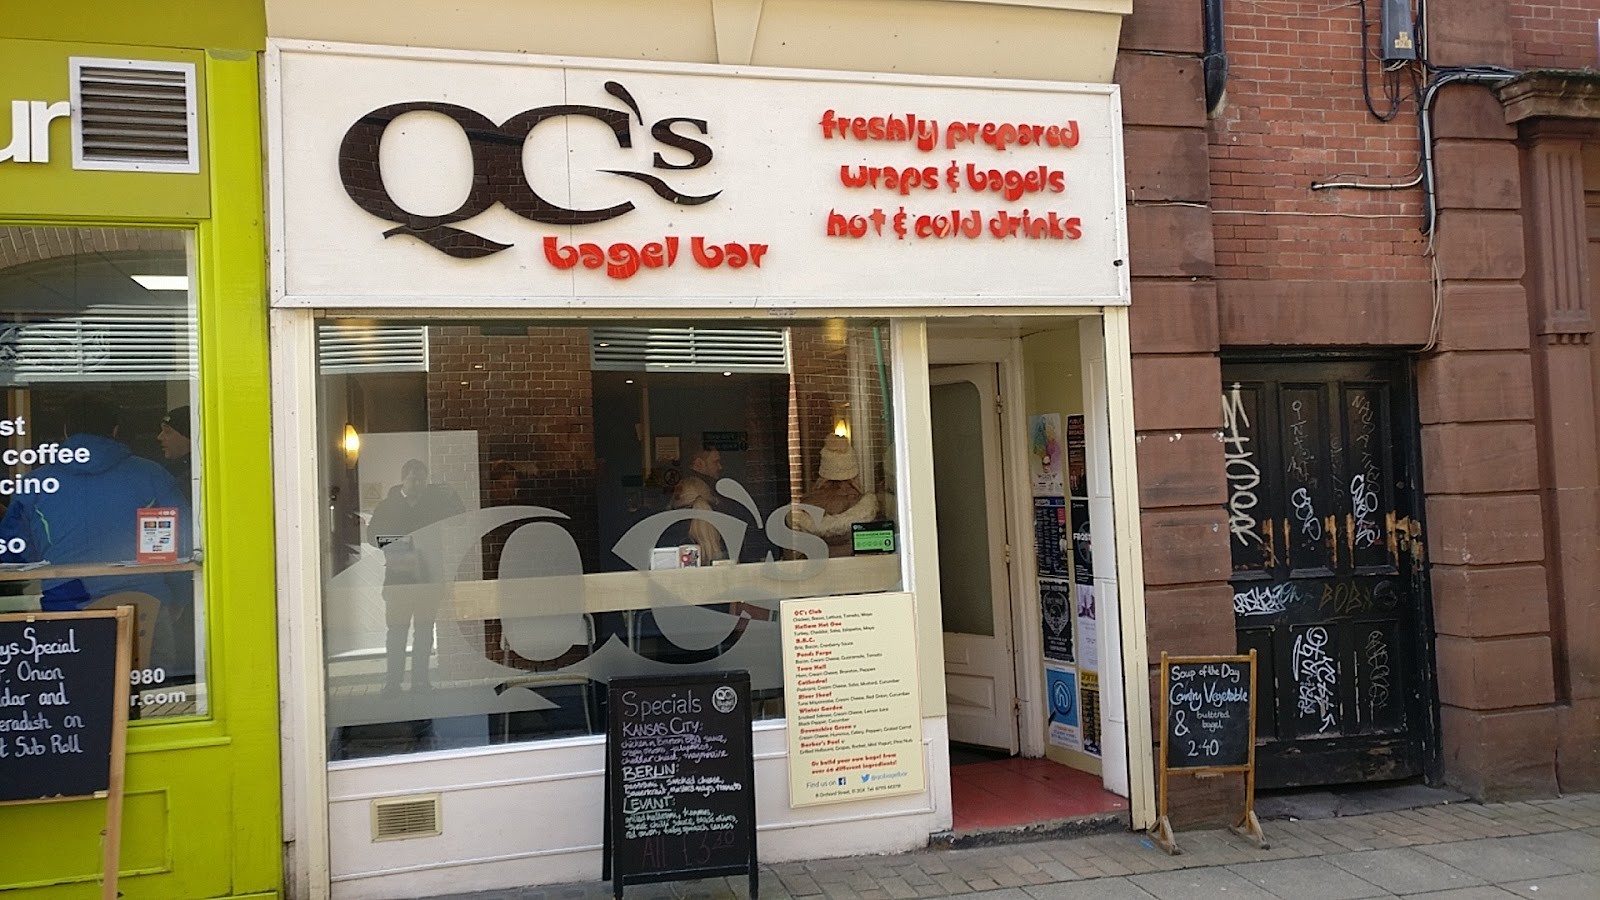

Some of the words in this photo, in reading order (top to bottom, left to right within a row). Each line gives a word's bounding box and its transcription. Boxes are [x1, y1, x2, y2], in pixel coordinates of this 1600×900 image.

[818, 109, 939, 153] freshly
[946, 120, 1080, 152] prepared
[339, 80, 724, 259] QC's
[840, 164, 939, 196] wraps
[946, 160, 960, 194] &
[966, 163, 1066, 202] bagels
[827, 207, 887, 239] hot
[893, 206, 908, 240] &
[915, 209, 982, 239] cold
[989, 208, 1083, 240] drinks
[543, 236, 679, 280] bagel
[690, 236, 769, 269] bar
[0, 416, 26, 437] st
[2, 443, 91, 466] coffee
[0, 474, 61, 496] cino
[21, 627, 82, 664] Special
[17, 660, 65, 682] Onion
[130, 667, 166, 686] 980
[798, 678, 828, 686] Cathedral
[1171, 665, 1196, 682] Soup
[1198, 665, 1208, 678] of
[1207, 664, 1220, 676] the
[1221, 663, 1241, 683] Day
[0, 686, 31, 707] dar
[38, 681, 70, 706] and
[1203, 681, 1249, 708] Vegetable
[621, 690, 703, 722] Specials
[63, 714, 85, 729] on
[622, 720, 669, 737] KANSAS
[800, 727, 833, 735] Devonshire
[1174, 709, 1191, 737] &
[1201, 719, 1224, 733] bagel
[15, 735, 46, 758] Sub
[50, 733, 84, 755] Roll
[835, 764, 862, 772] different
[806, 781, 820, 789] Find
